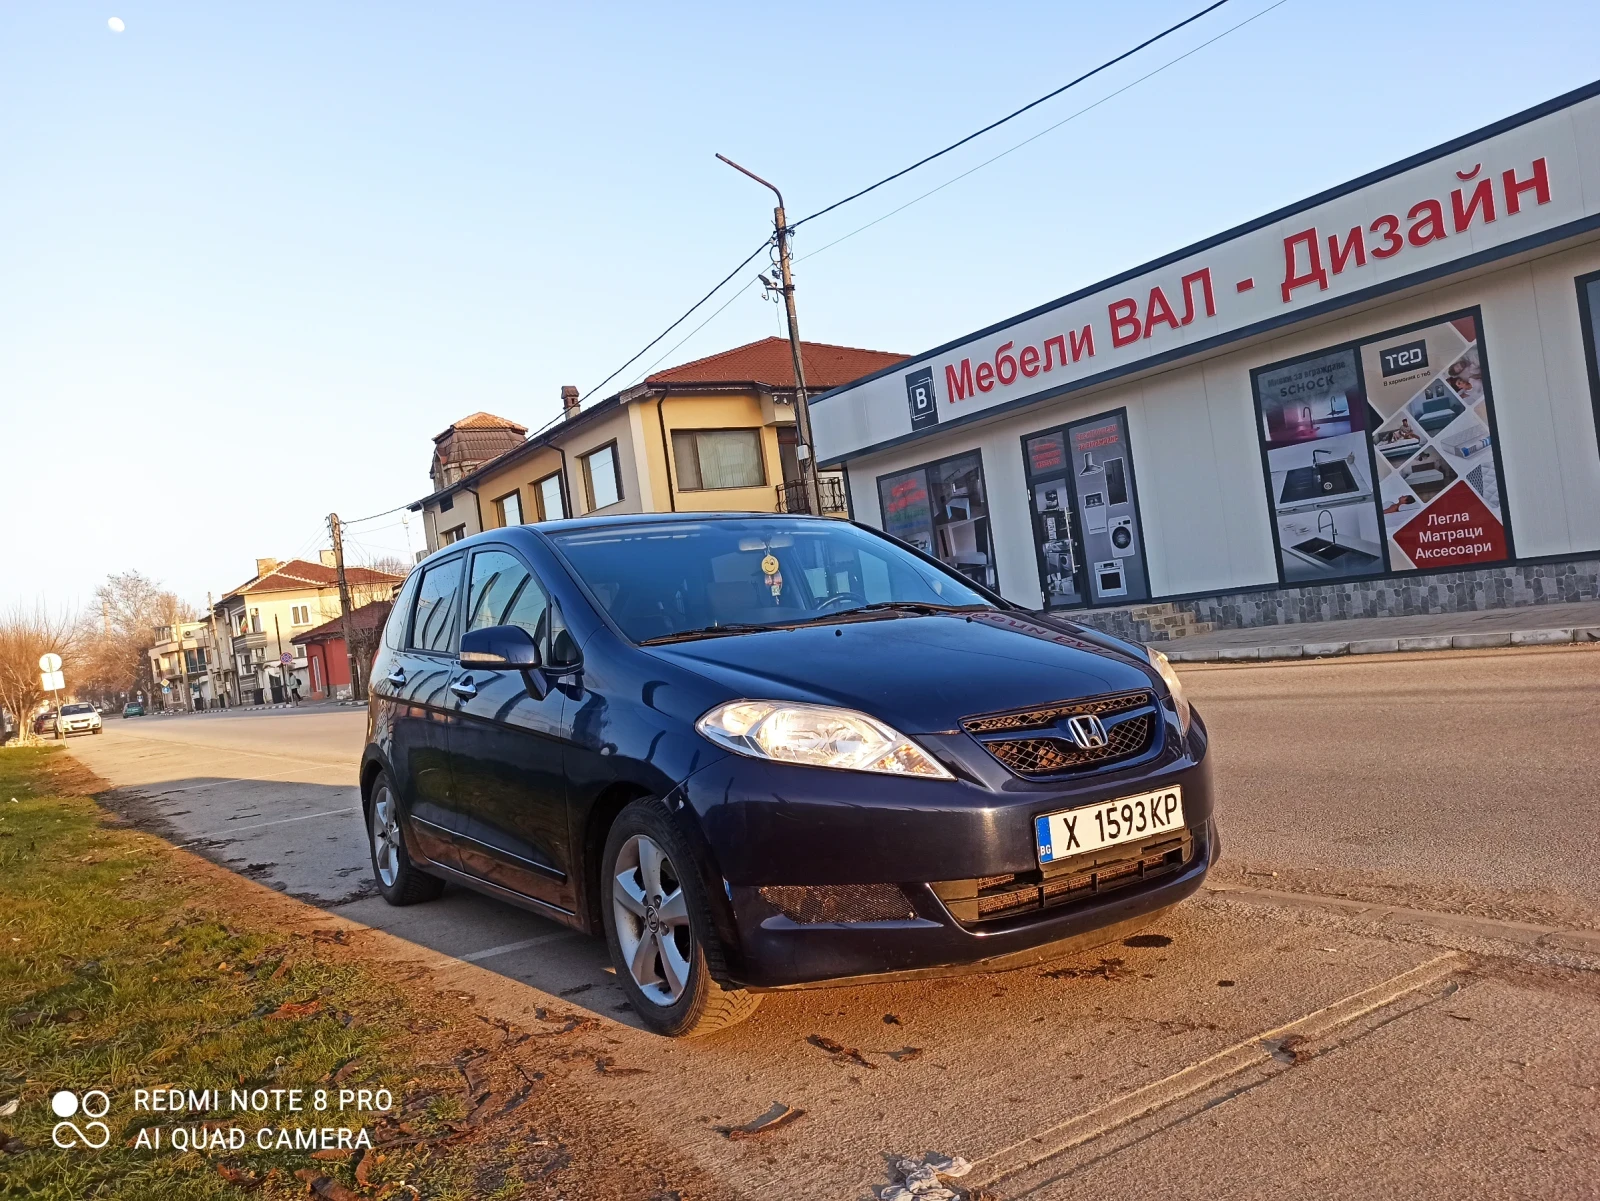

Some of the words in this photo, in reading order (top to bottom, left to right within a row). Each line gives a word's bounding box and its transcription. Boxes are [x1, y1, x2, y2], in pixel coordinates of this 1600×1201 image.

[944, 323, 1096, 404] Мебели
[1107, 266, 1217, 349] ВАЛ
[1280, 156, 1552, 303] Дизайн
[1304, 361, 1346, 378] вграждане
[1280, 374, 1335, 397] SCHOCK
[1427, 512, 1470, 526] Легла
[1418, 526, 1483, 543] Матраци
[1415, 542, 1492, 560] Аксесоари
[1040, 844, 1052, 856] BG
